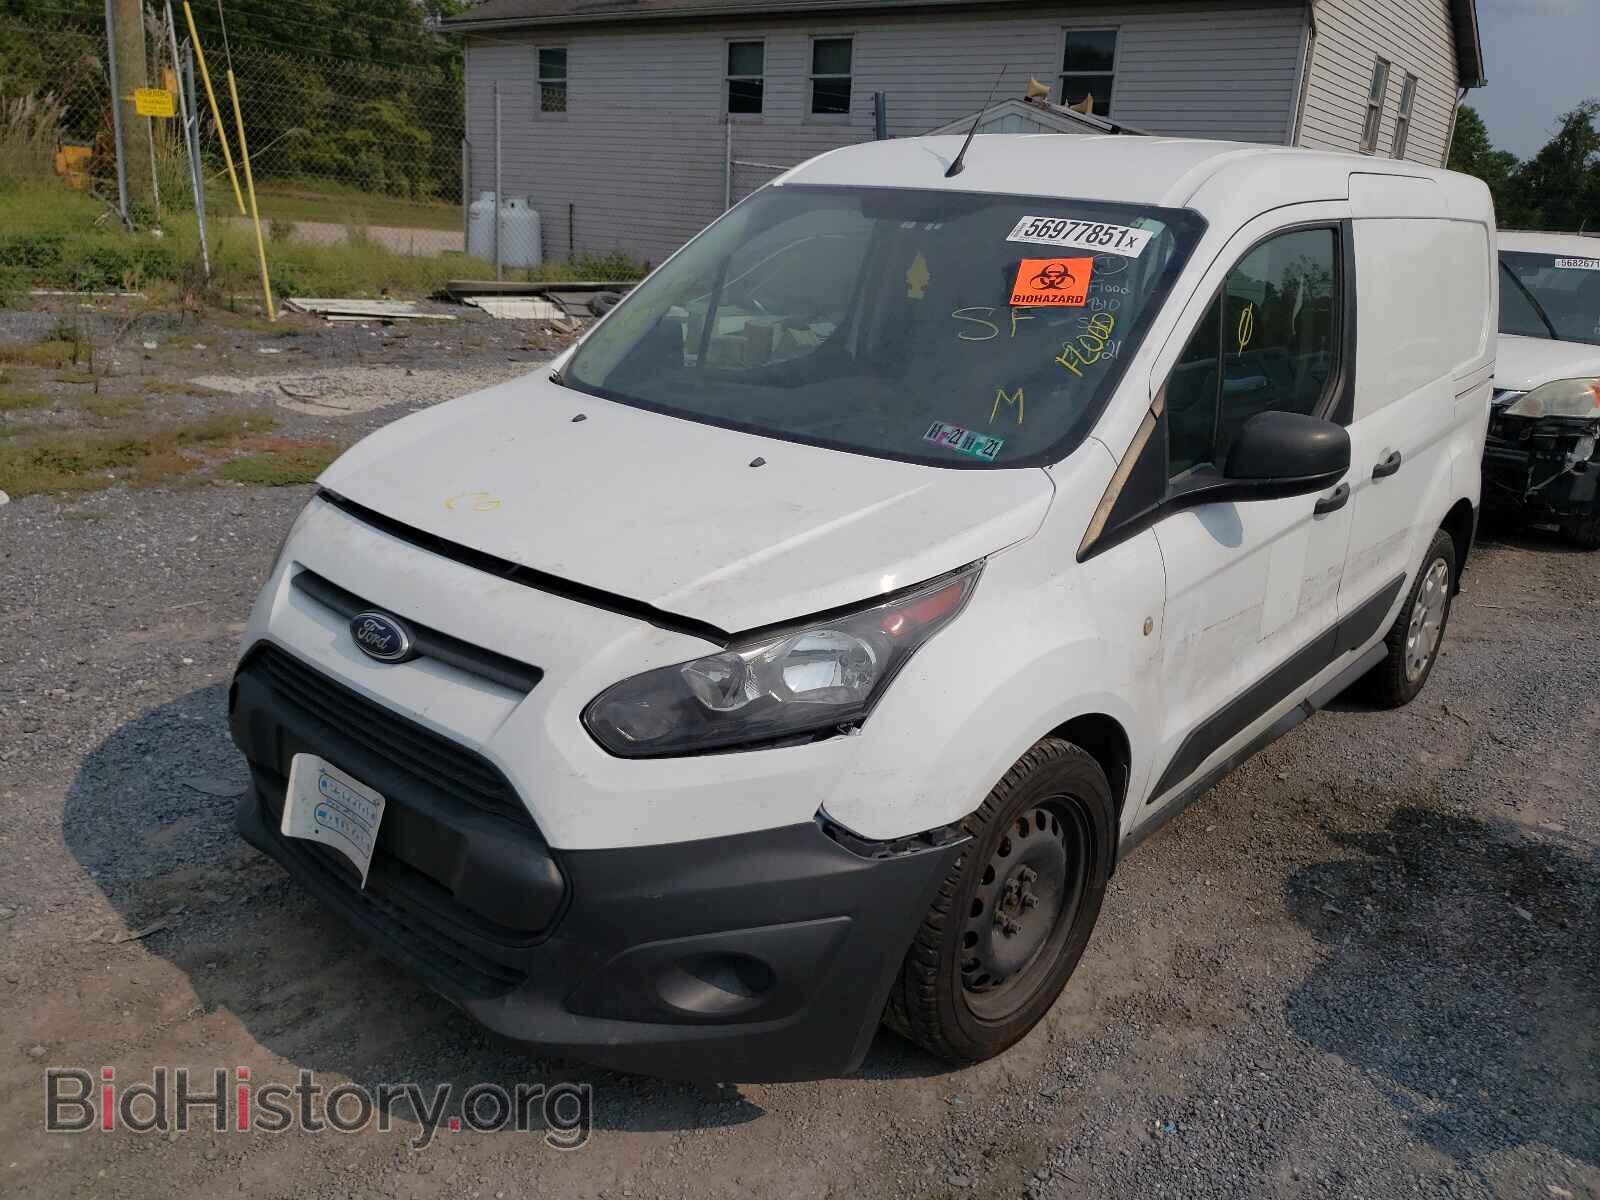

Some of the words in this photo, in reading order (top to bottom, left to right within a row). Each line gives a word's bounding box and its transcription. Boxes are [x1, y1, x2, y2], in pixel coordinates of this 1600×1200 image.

[1013, 294, 1084, 304] BIOHAZARD
[988, 386, 1025, 425] M
[357, 618, 393, 651] Ford
